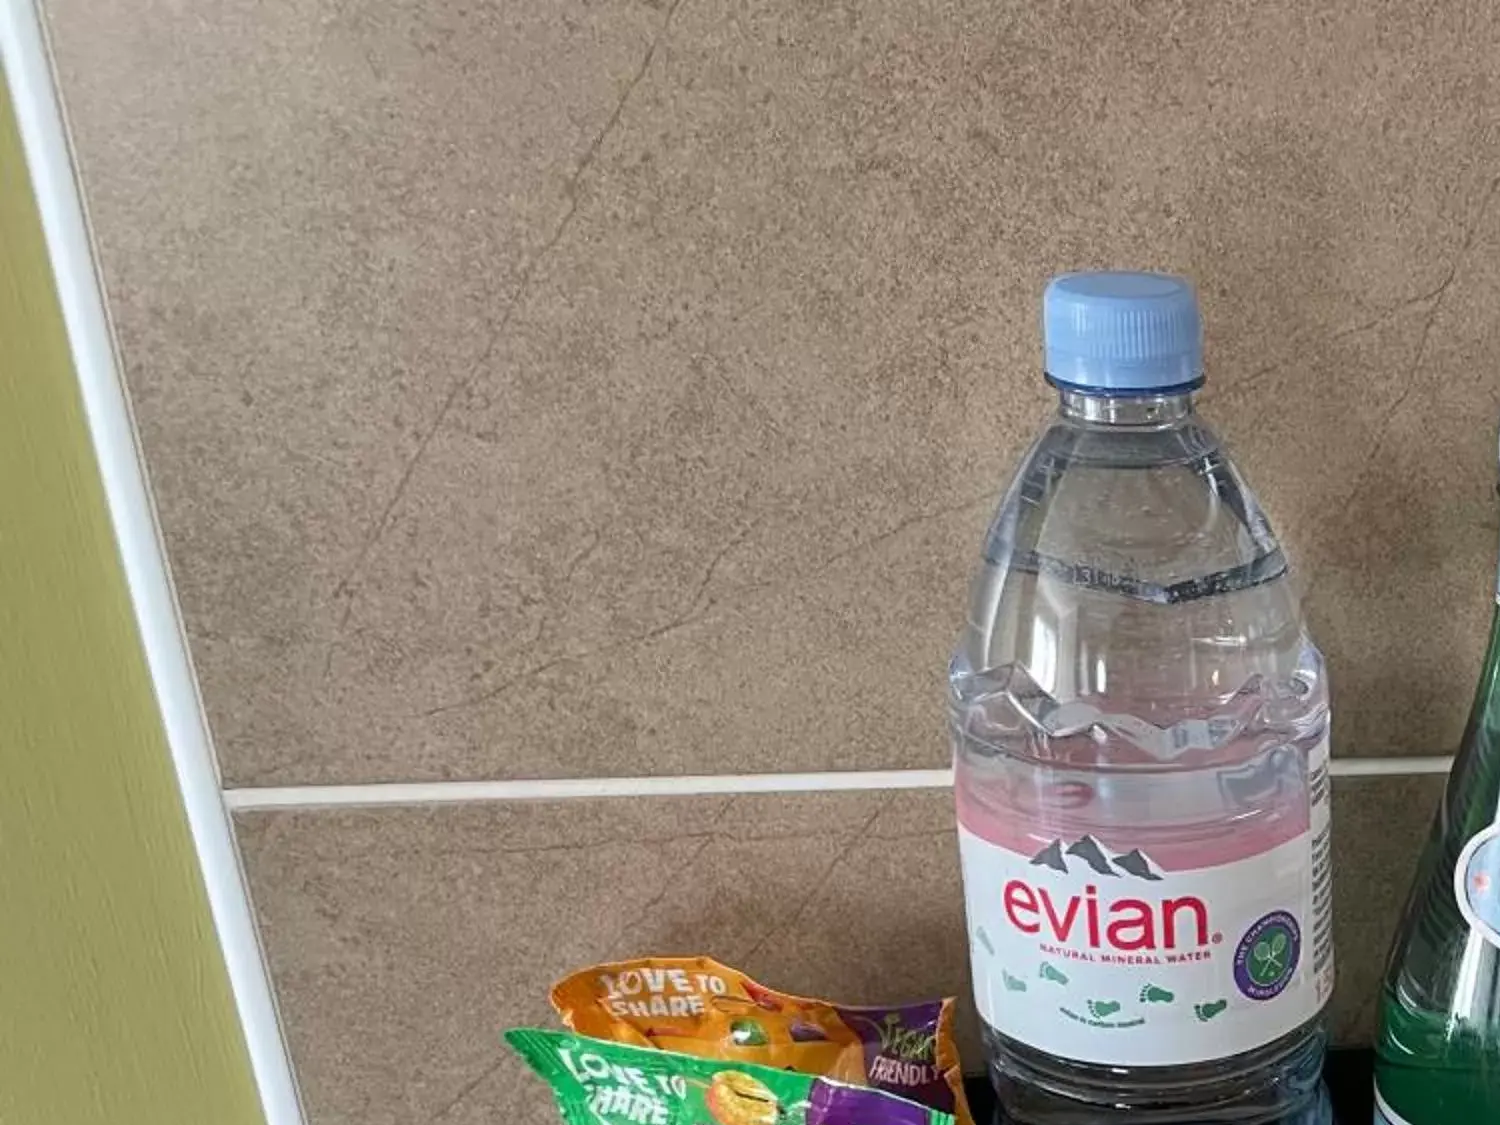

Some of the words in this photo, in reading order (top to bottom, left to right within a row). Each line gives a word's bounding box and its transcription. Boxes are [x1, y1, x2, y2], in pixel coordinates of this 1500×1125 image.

[1003, 879, 1209, 950] evian
[1040, 942, 1096, 963] NATURAL
[1101, 953, 1161, 965] MINERAL
[1167, 950, 1211, 963] WATER
[600, 967, 694, 999] LOVE
[695, 973, 727, 995] TO
[610, 994, 705, 1017] SHARE
[558, 1049, 658, 1096] LOVE
[654, 1075, 687, 1101] TO
